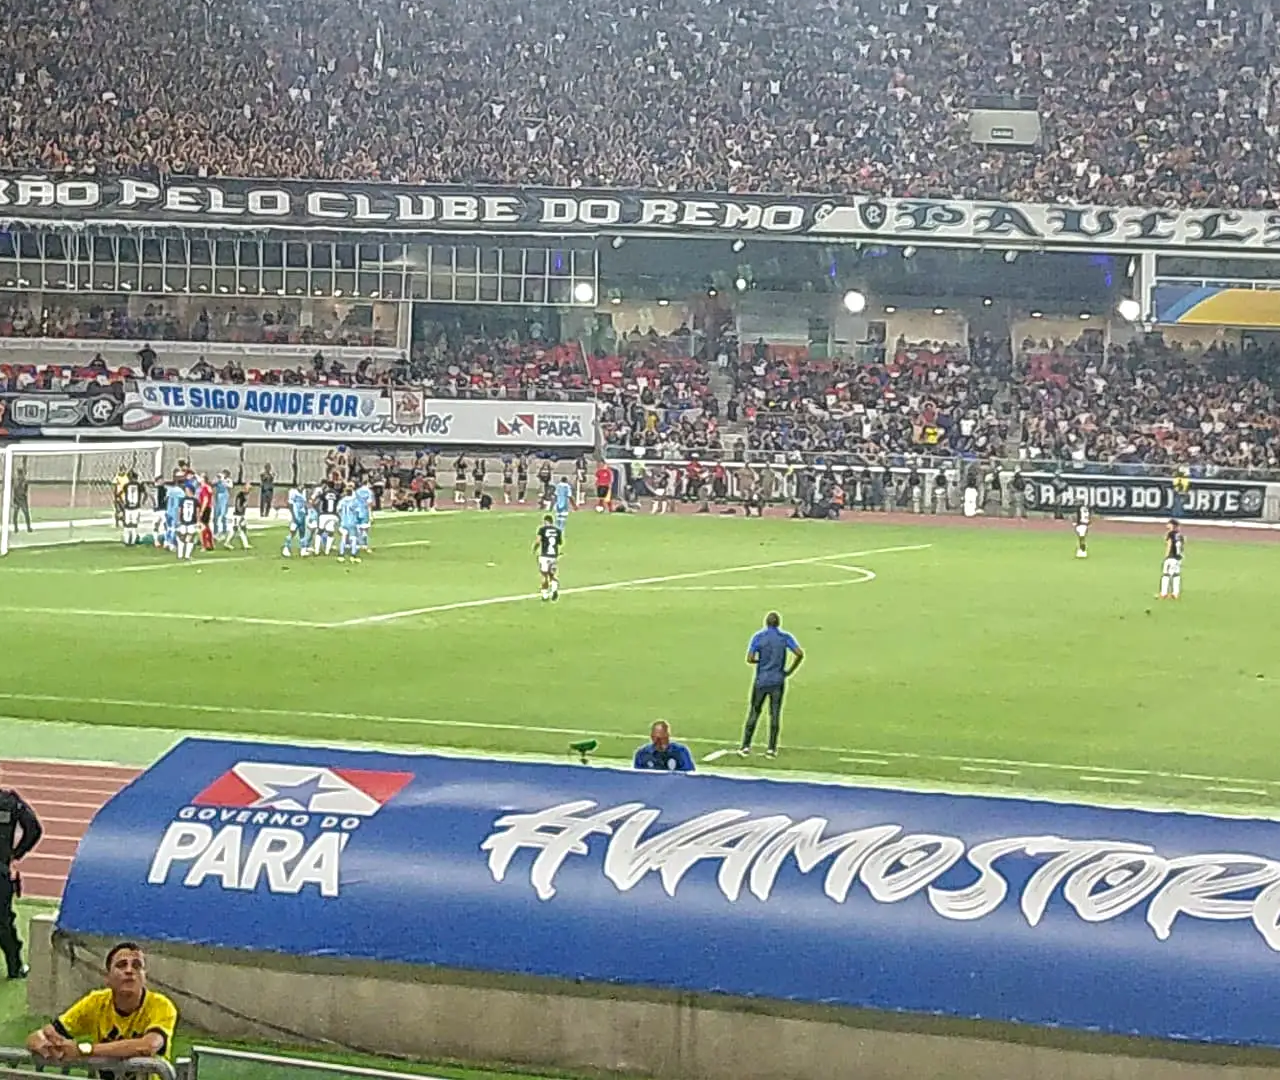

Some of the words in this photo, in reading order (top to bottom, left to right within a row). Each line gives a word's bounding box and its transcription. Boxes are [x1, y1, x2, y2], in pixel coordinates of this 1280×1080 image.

[119, 177, 291, 216] PELO
[307, 190, 520, 223] CLUBE
[539, 197, 622, 224] DO
[640, 197, 805, 231] REMO
[159, 385, 184, 406] TE
[190, 387, 241, 410] SIGO
[244, 390, 312, 416] AONDE
[319, 393, 358, 418] FOR
[1040, 483, 1057, 506] A
[1131, 486, 1162, 508] DO
[178, 806, 309, 827] GOVERNO
[320, 816, 361, 830] DO
[147, 820, 350, 897] PARÁ
